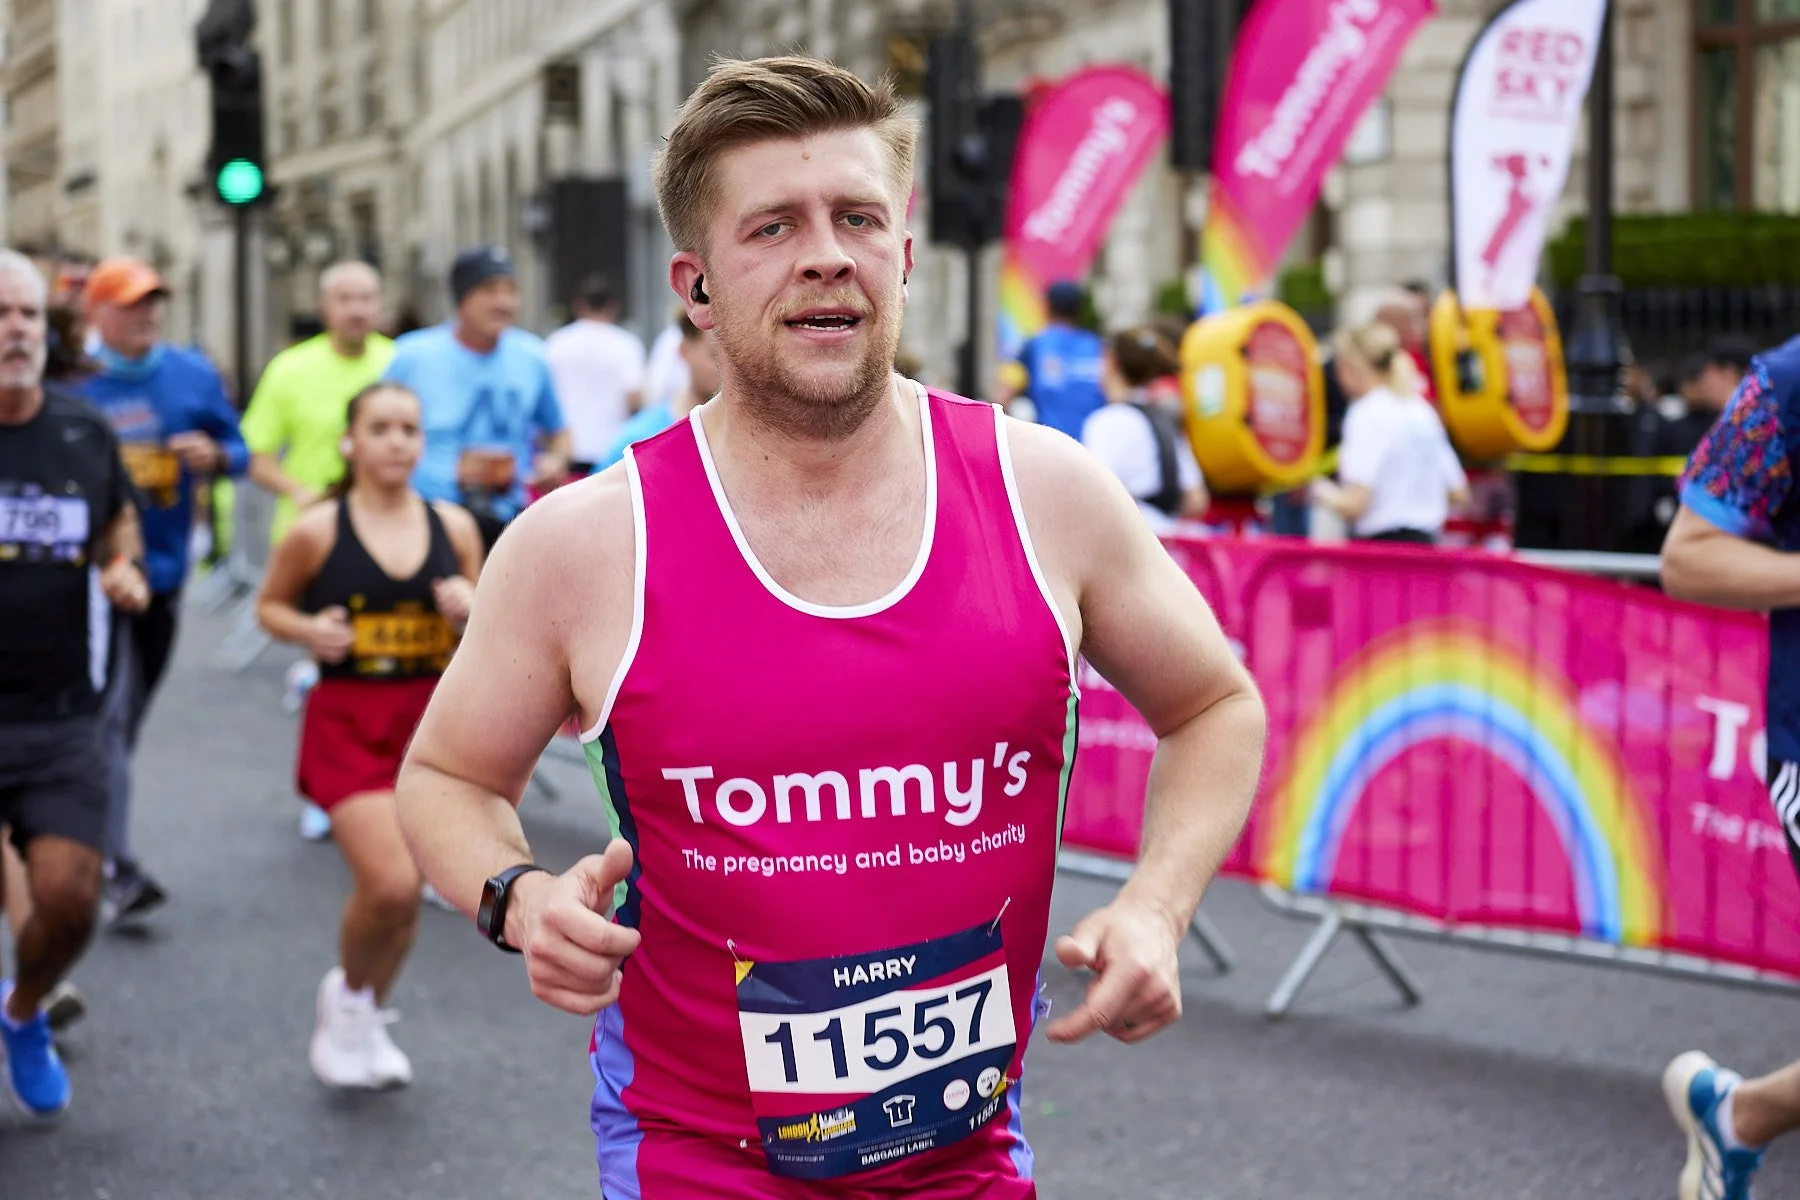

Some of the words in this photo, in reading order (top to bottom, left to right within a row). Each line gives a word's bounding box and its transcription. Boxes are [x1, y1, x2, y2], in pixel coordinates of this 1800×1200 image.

[661, 742, 1031, 828] Tommy's
[682, 849, 717, 872] The
[724, 853, 848, 877] pregnancy
[855, 844, 901, 869] and
[908, 839, 966, 865] baby
[970, 823, 1026, 855] charity
[833, 954, 917, 988] HARRY
[765, 978, 993, 1083] 11557
[778, 1121, 810, 1140] LONDON
[861, 1145, 906, 1166] BAGGAGE
[907, 1138, 935, 1154] LABEL
